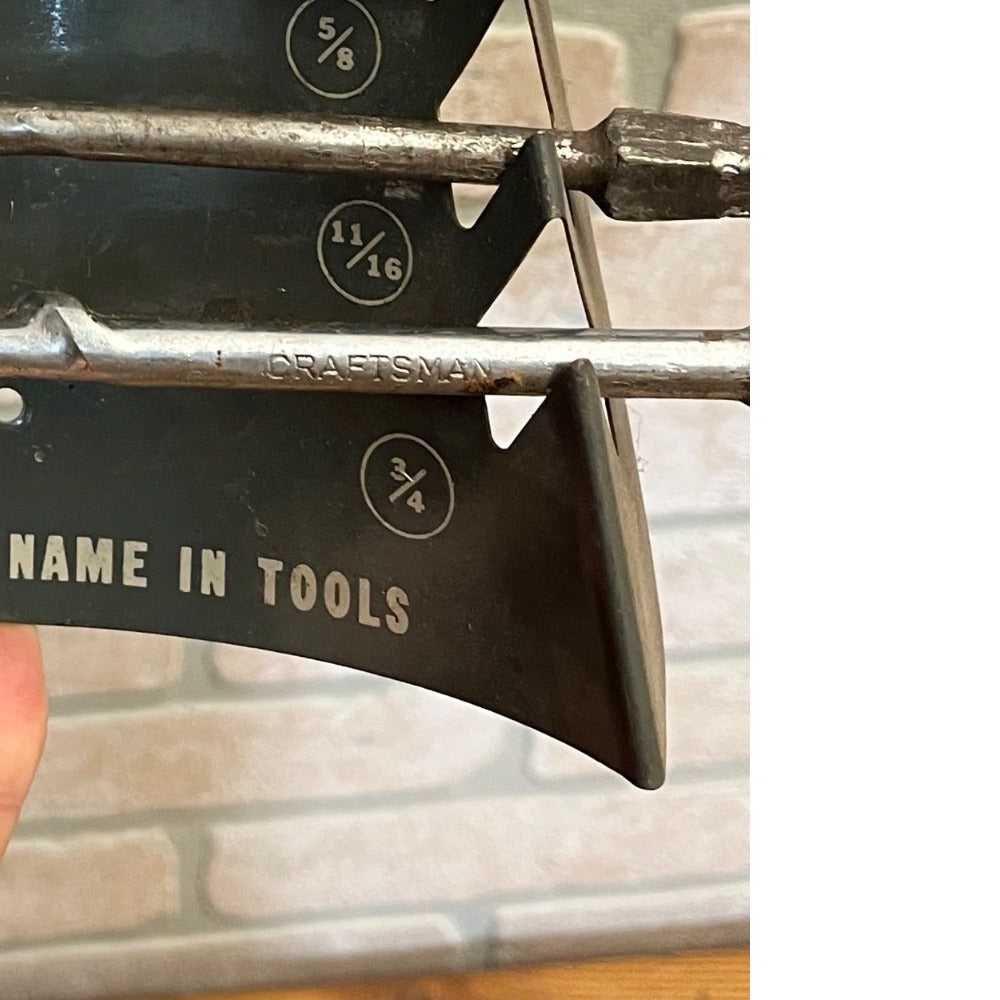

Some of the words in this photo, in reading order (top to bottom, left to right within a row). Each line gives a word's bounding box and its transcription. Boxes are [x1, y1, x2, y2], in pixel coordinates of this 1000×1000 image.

[317, 16, 355, 71] 5/8
[331, 219, 403, 281] 11/16
[262, 352, 495, 384] CRAFTSMAN
[388, 457, 427, 514] 3/4
[9, 533, 148, 588] NAME
[179, 546, 226, 597] IN
[257, 556, 410, 635] TOOLS
